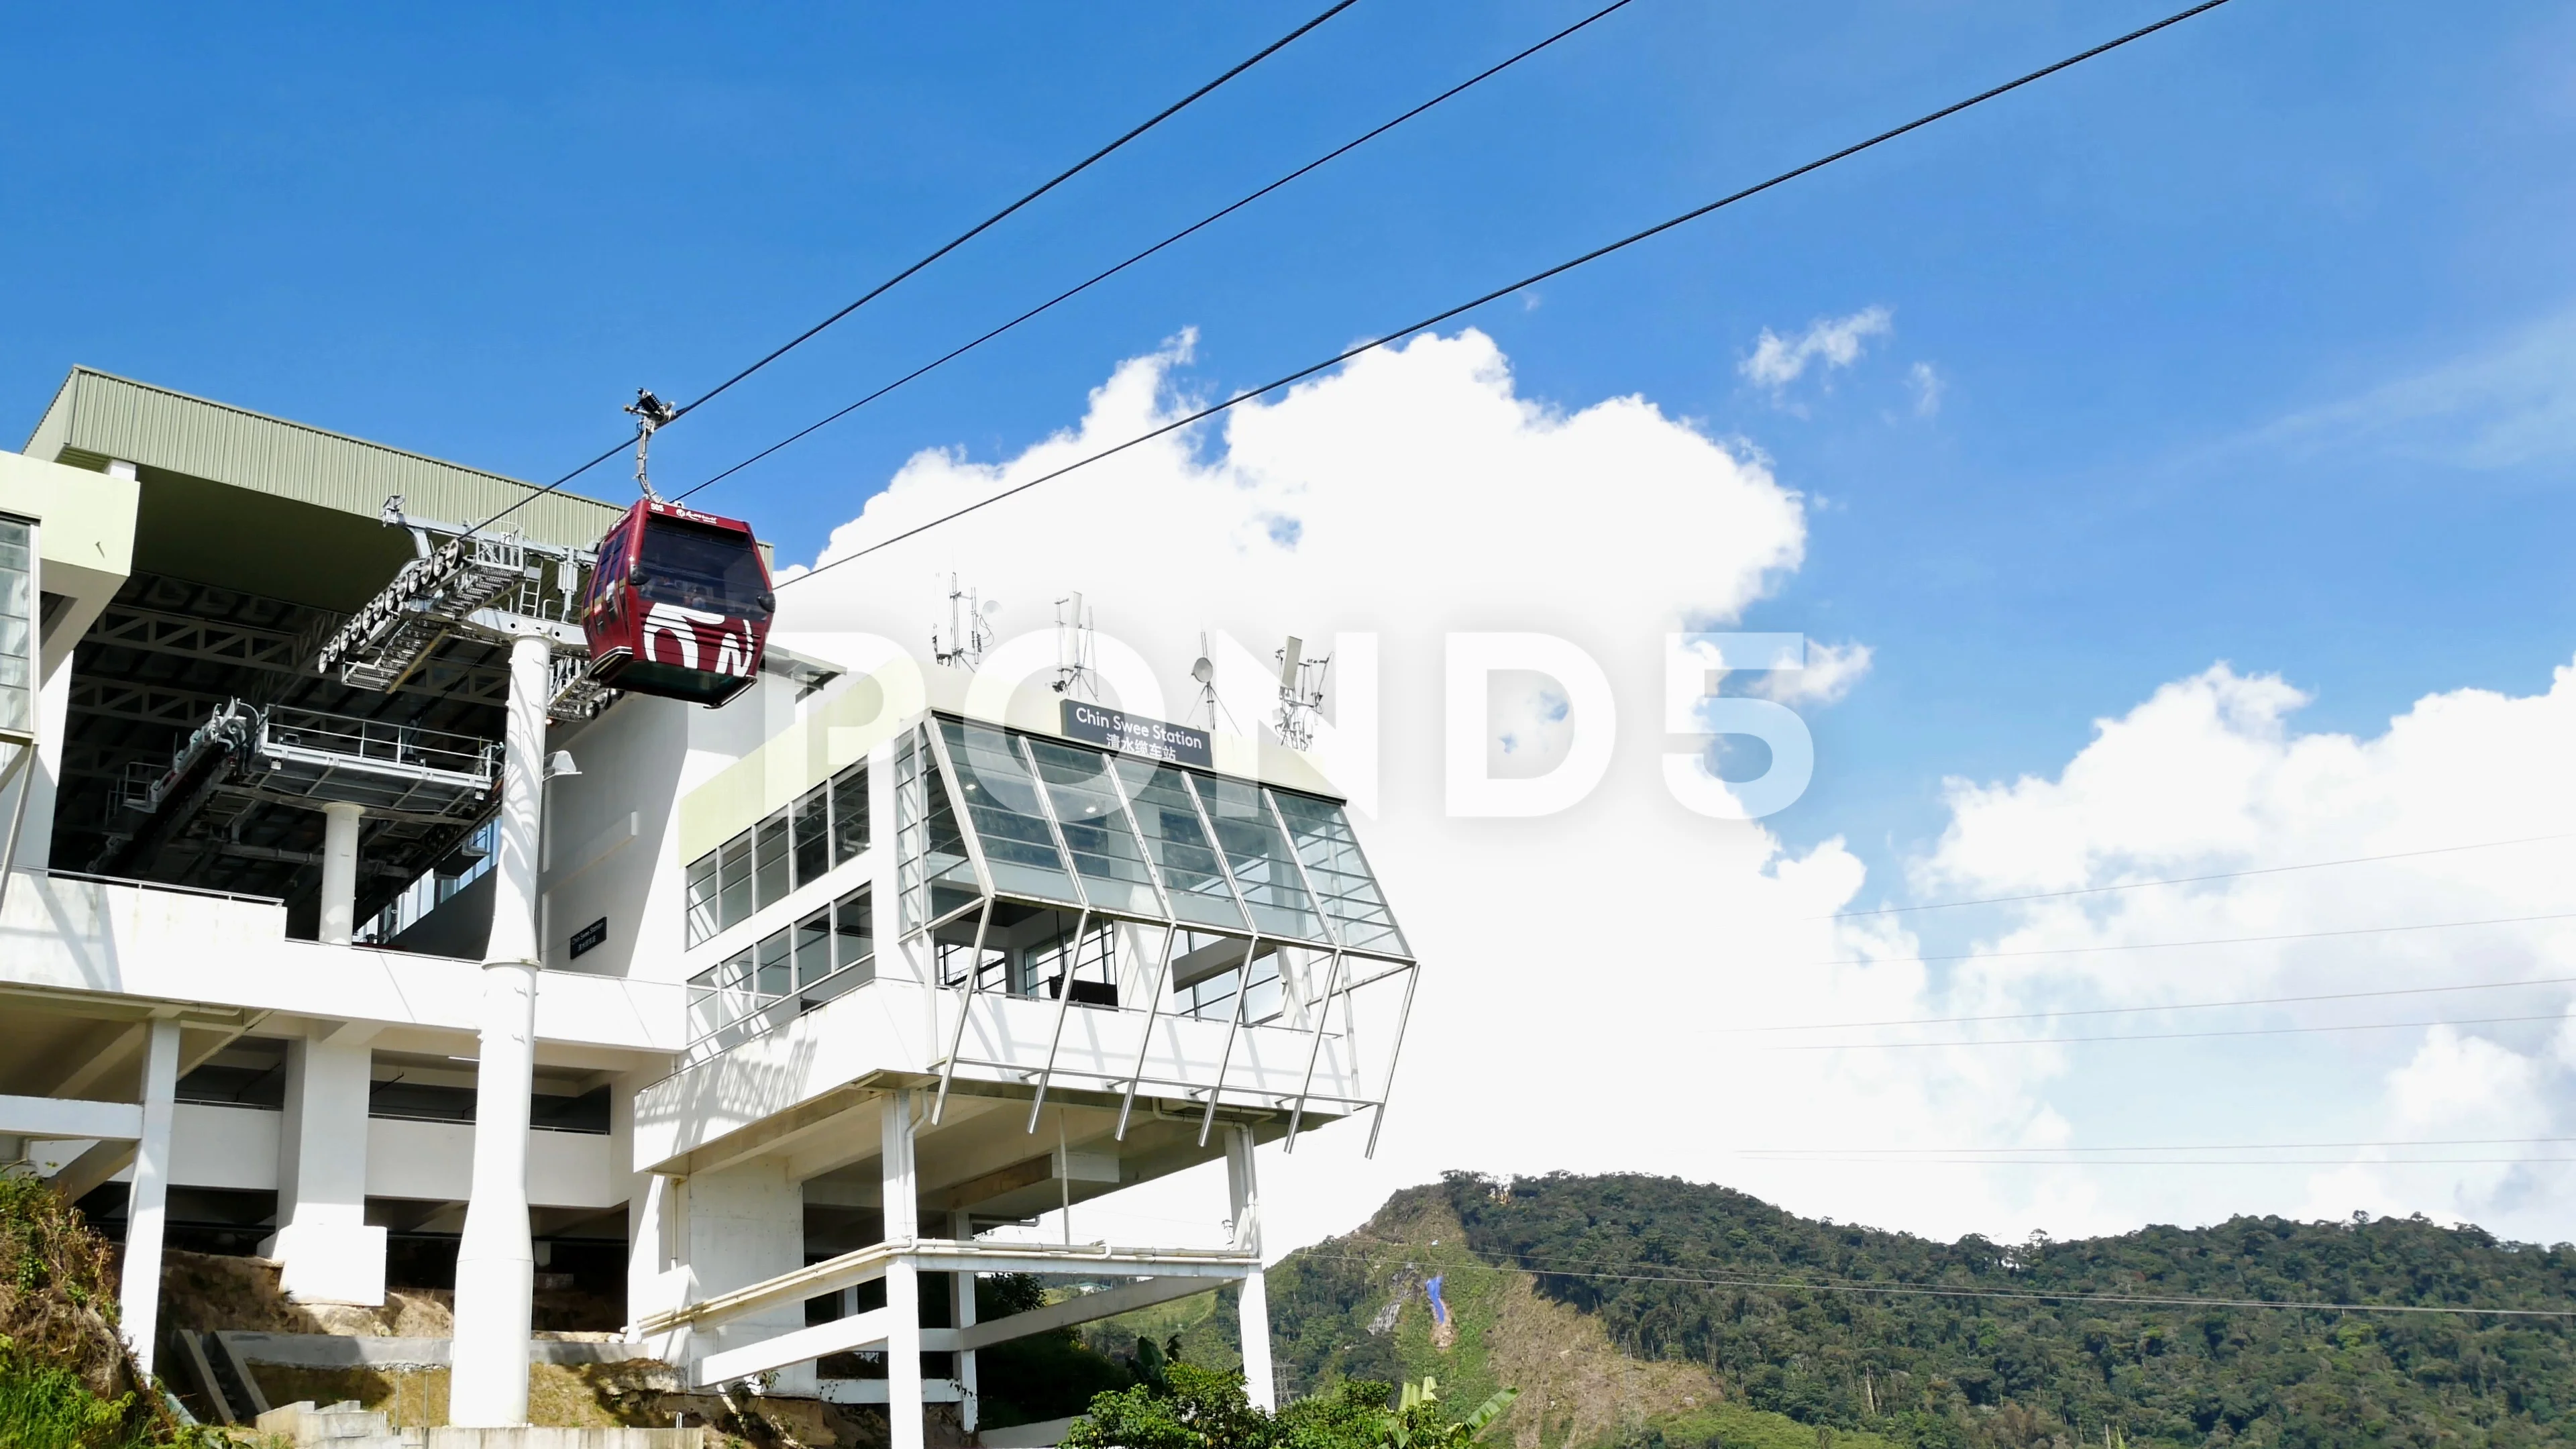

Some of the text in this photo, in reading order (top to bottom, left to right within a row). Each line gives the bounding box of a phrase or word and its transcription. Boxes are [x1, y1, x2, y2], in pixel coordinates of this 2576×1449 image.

[1075, 706, 1202, 749] Chin Swee Station
[1106, 732, 1176, 761] 清水缆车站
